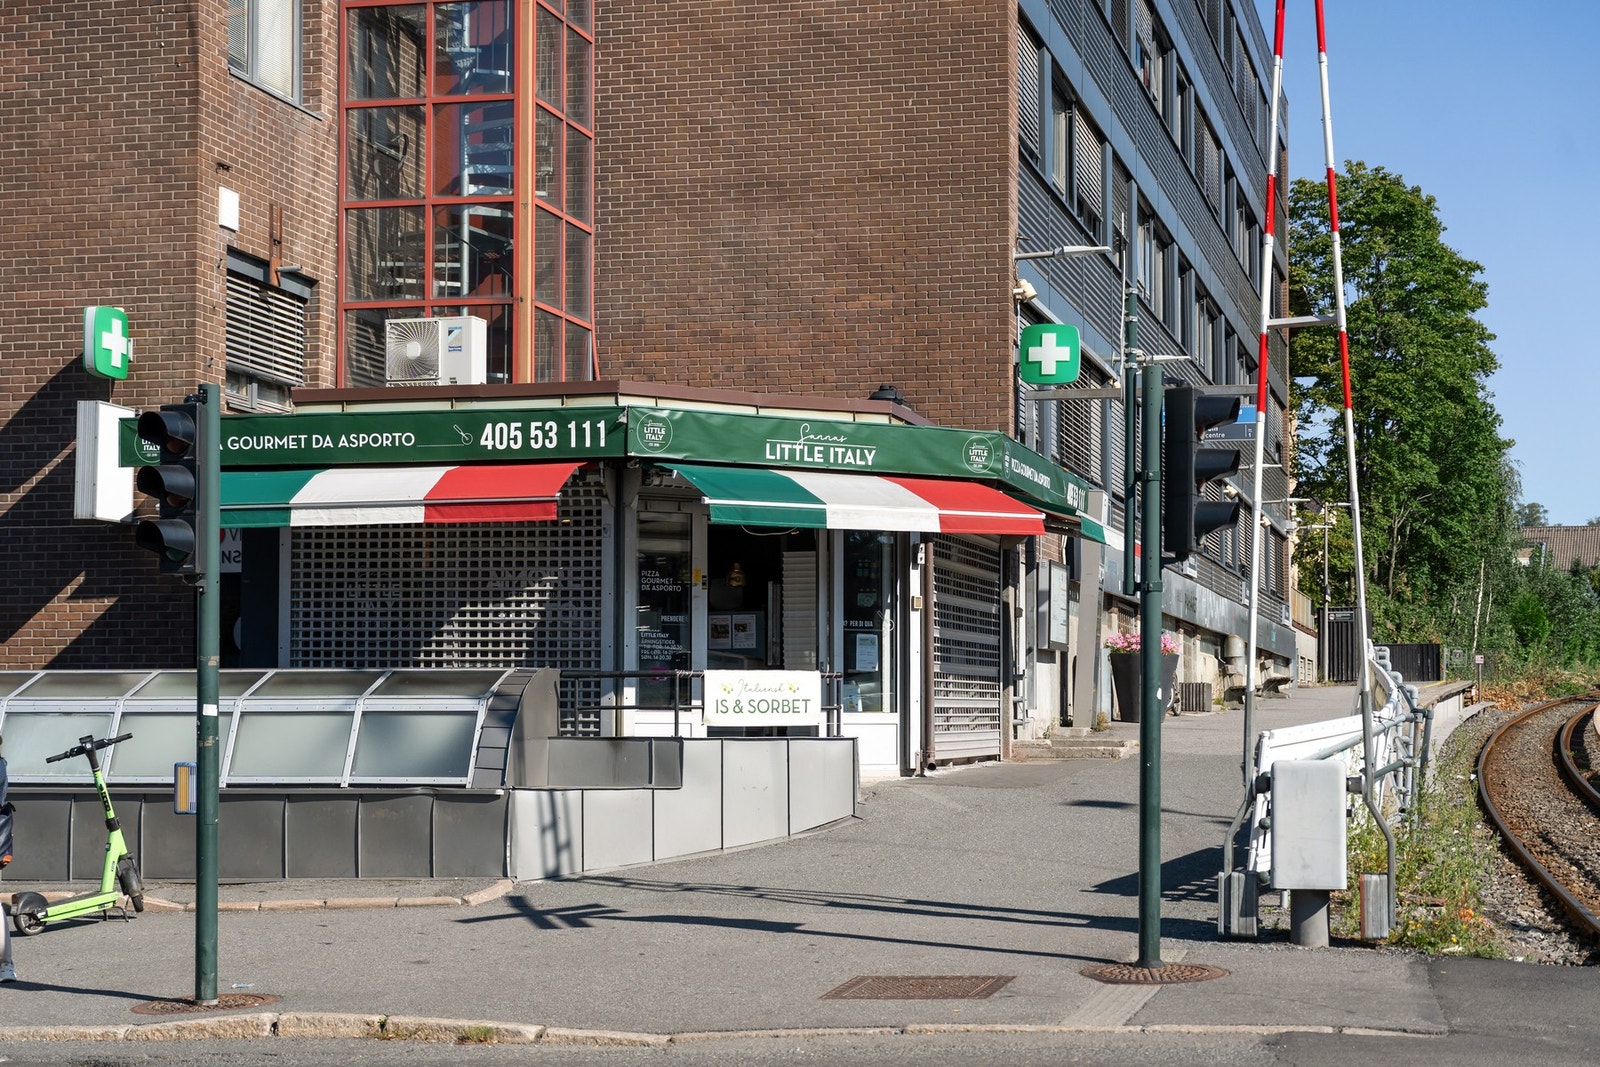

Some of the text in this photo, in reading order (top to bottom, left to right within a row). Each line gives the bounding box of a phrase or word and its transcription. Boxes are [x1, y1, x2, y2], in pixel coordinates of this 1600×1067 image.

[227, 420, 606, 450] GOURMET DA ASPORTO 405 53 111
[643, 426, 666, 435] LITTLE
[645, 433, 664, 441] ITALY
[797, 423, 848, 446] Sannas
[765, 443, 877, 466] LITTLE ITALY
[969, 449, 988, 457] LITTLE
[641, 577, 673, 585] GOURMET
[737, 678, 785, 697] Italiensk
[715, 699, 811, 714] IS & SORBET
